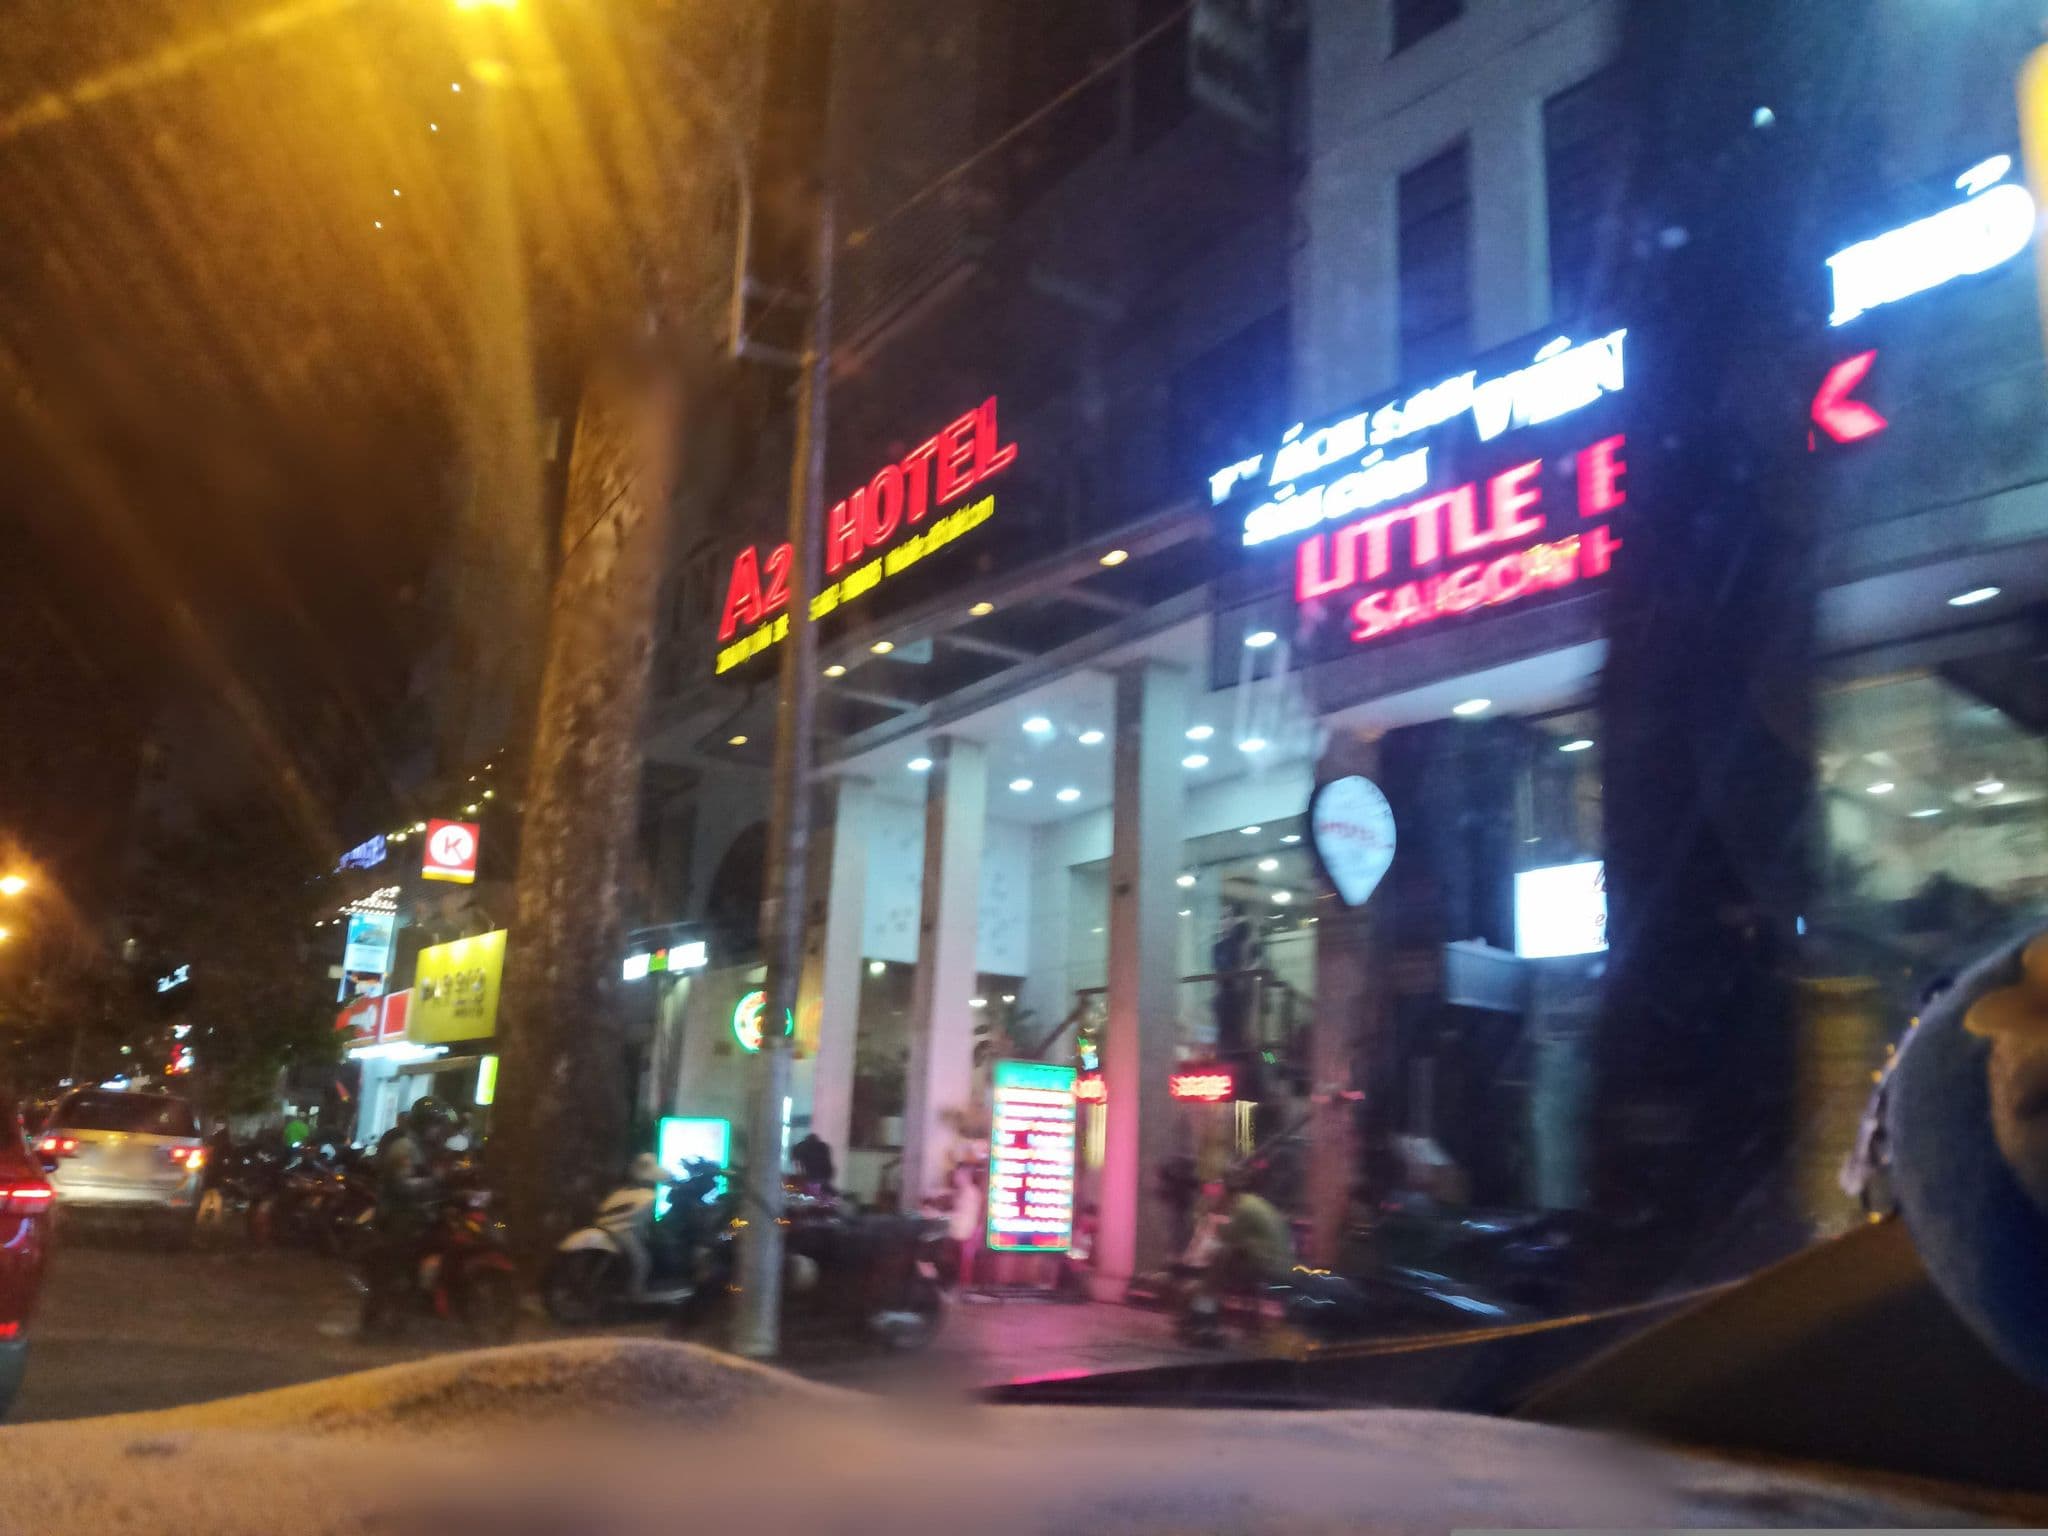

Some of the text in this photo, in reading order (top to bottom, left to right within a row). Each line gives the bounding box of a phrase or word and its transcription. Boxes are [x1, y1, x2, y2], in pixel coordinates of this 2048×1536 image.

[718, 542, 793, 641] A2
[826, 394, 1018, 576] HOTEL
[1296, 457, 1546, 602] LITTLE
